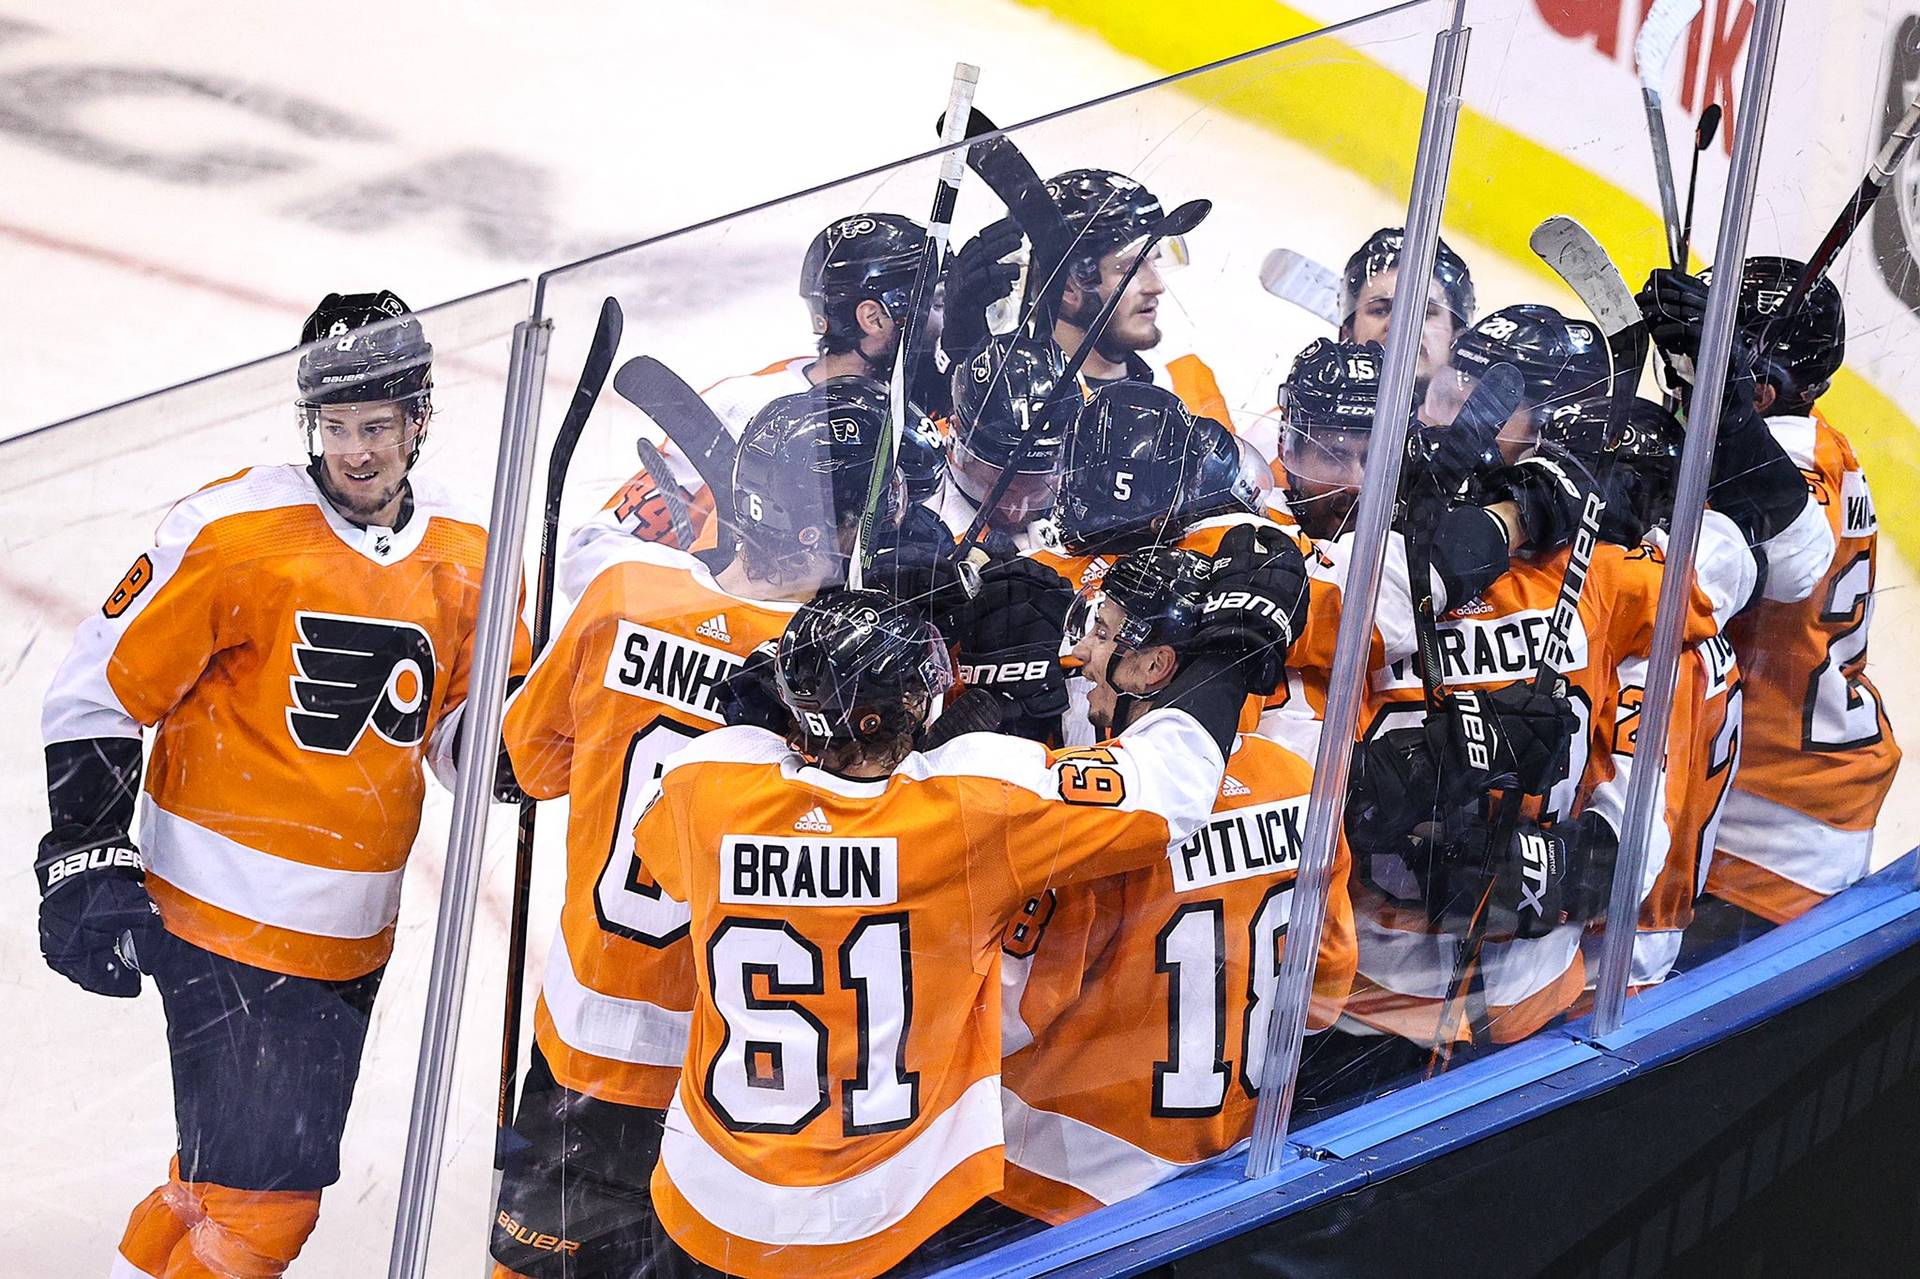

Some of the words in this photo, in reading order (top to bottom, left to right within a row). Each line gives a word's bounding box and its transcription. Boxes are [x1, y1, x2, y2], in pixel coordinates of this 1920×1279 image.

[1478, 316, 1519, 340] 28
[321, 373, 365, 384] BAUER
[1346, 359, 1377, 381] 15
[1113, 471, 1134, 501] 5
[749, 494, 763, 522] 6
[101, 552, 153, 619] 8
[1543, 492, 1607, 674] BAUER
[1203, 591, 1293, 648] BAUER
[1456, 603, 1495, 616] adidas
[696, 624, 732, 644] adidas
[1391, 617, 1576, 681] RACE
[618, 632, 744, 712] SANH
[804, 711, 834, 737] 61
[1221, 786, 1253, 798] adidas
[794, 820, 833, 833] adidas
[1180, 805, 1304, 882] PITLICK
[46, 846, 146, 888] BAUER
[733, 843, 881, 898] BRAUN
[1516, 831, 1549, 918] STX
[703, 911, 921, 1138] 61
[497, 1209, 581, 1258] BAUER
